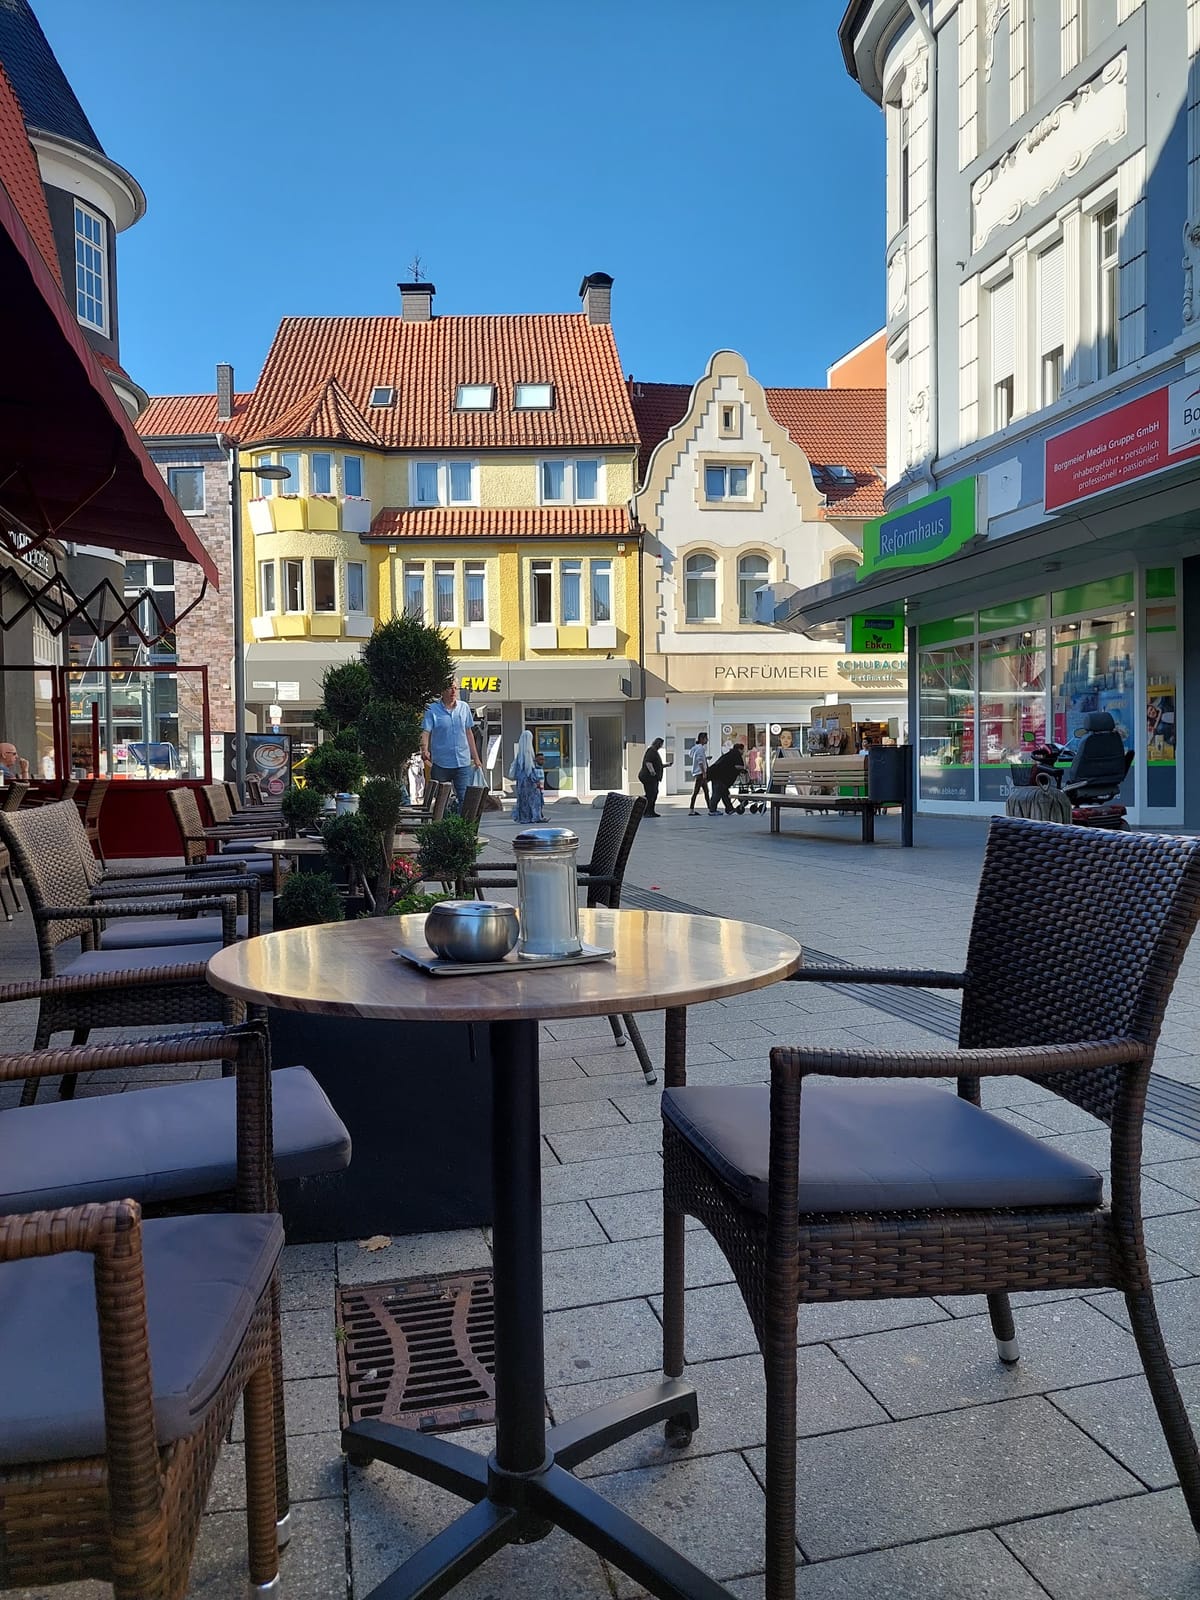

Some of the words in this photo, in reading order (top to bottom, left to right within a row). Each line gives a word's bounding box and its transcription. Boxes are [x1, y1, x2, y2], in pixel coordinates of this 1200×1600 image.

[1053, 453, 1085, 473] Borgmeier
[1086, 443, 1107, 458] Media
[1108, 433, 1135, 448] Gruppe
[1136, 421, 1160, 438] GmbH
[1073, 455, 1119, 480] inhabergeführt
[1124, 440, 1160, 461] persönlich
[1078, 468, 1118, 491] professionell
[1122, 453, 1159, 475] passioniert
[881, 518, 944, 556] Reformhaus
[865, 640, 892, 649] Ebken
[714, 664, 829, 679] PARFÜMERIE
[837, 660, 907, 670] SCHUBACK
[461, 676, 499, 691] EWE
